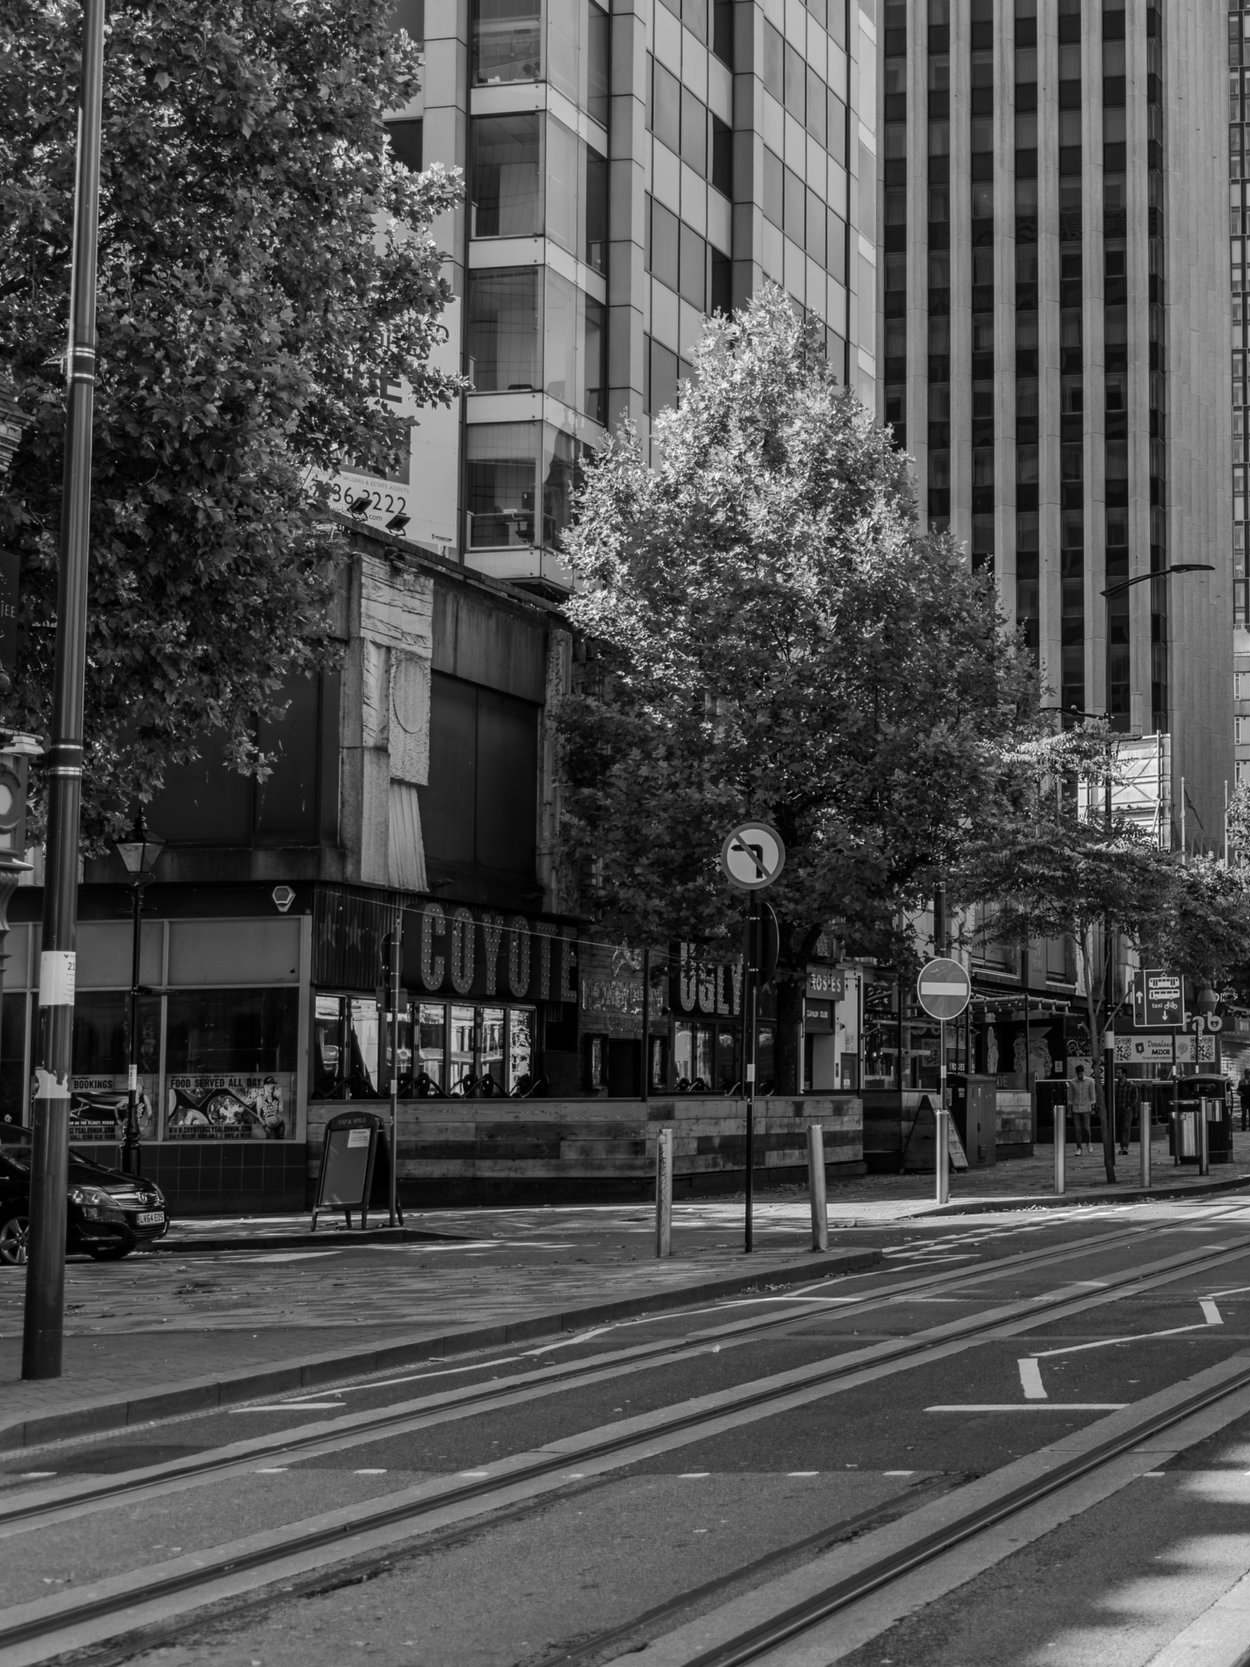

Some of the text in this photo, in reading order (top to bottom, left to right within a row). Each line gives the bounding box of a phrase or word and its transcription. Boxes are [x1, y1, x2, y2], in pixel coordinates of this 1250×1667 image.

[370, 480, 388, 489] ESTATE
[389, 485, 410, 494] AGENTS
[421, 902, 578, 1003] COYOTE
[680, 941, 744, 1016] UGLY
[74, 1080, 113, 1089] BOOKINGS
[170, 1078, 262, 1088] FOOD SERVED ALL DAY
